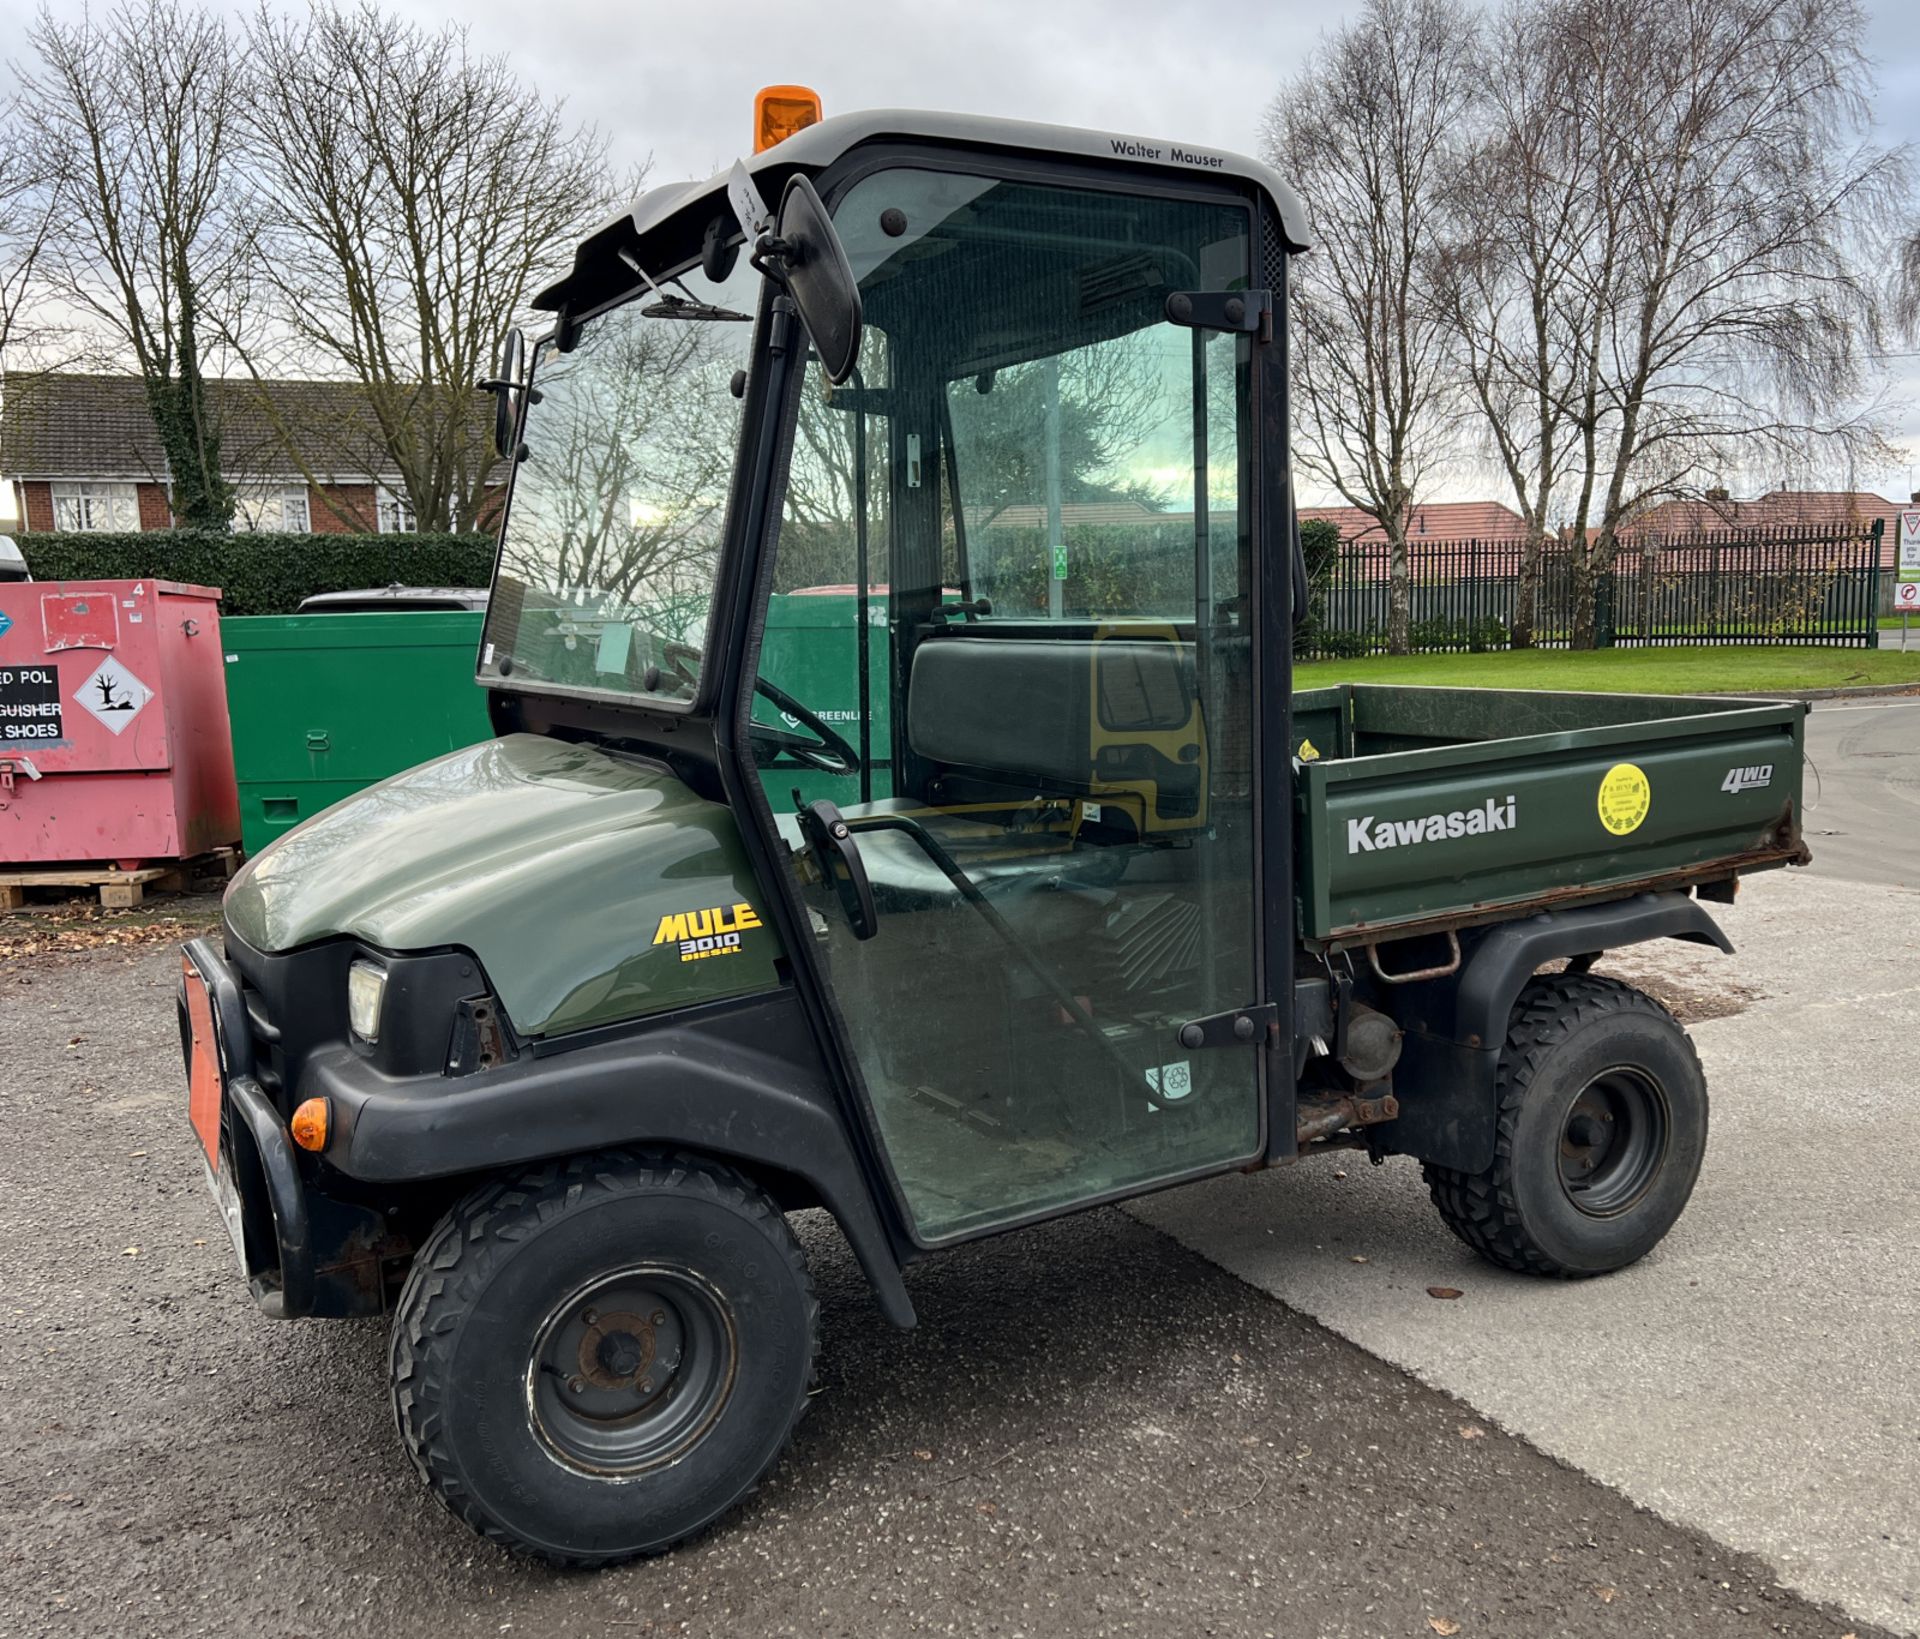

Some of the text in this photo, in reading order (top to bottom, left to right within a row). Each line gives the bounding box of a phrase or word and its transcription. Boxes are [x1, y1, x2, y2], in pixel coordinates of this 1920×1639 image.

[1110, 139, 1224, 168] Walter Mauser
[132, 582, 145, 596] 4
[20, 670, 53, 684] POL
[5, 723, 58, 739] SHOES
[1721, 764, 1773, 794] 4WD
[1347, 795, 1517, 855] Kawasaki
[652, 902, 764, 945] MULE
[679, 932, 740, 955] 3010
[681, 945, 743, 962] DIESEL
